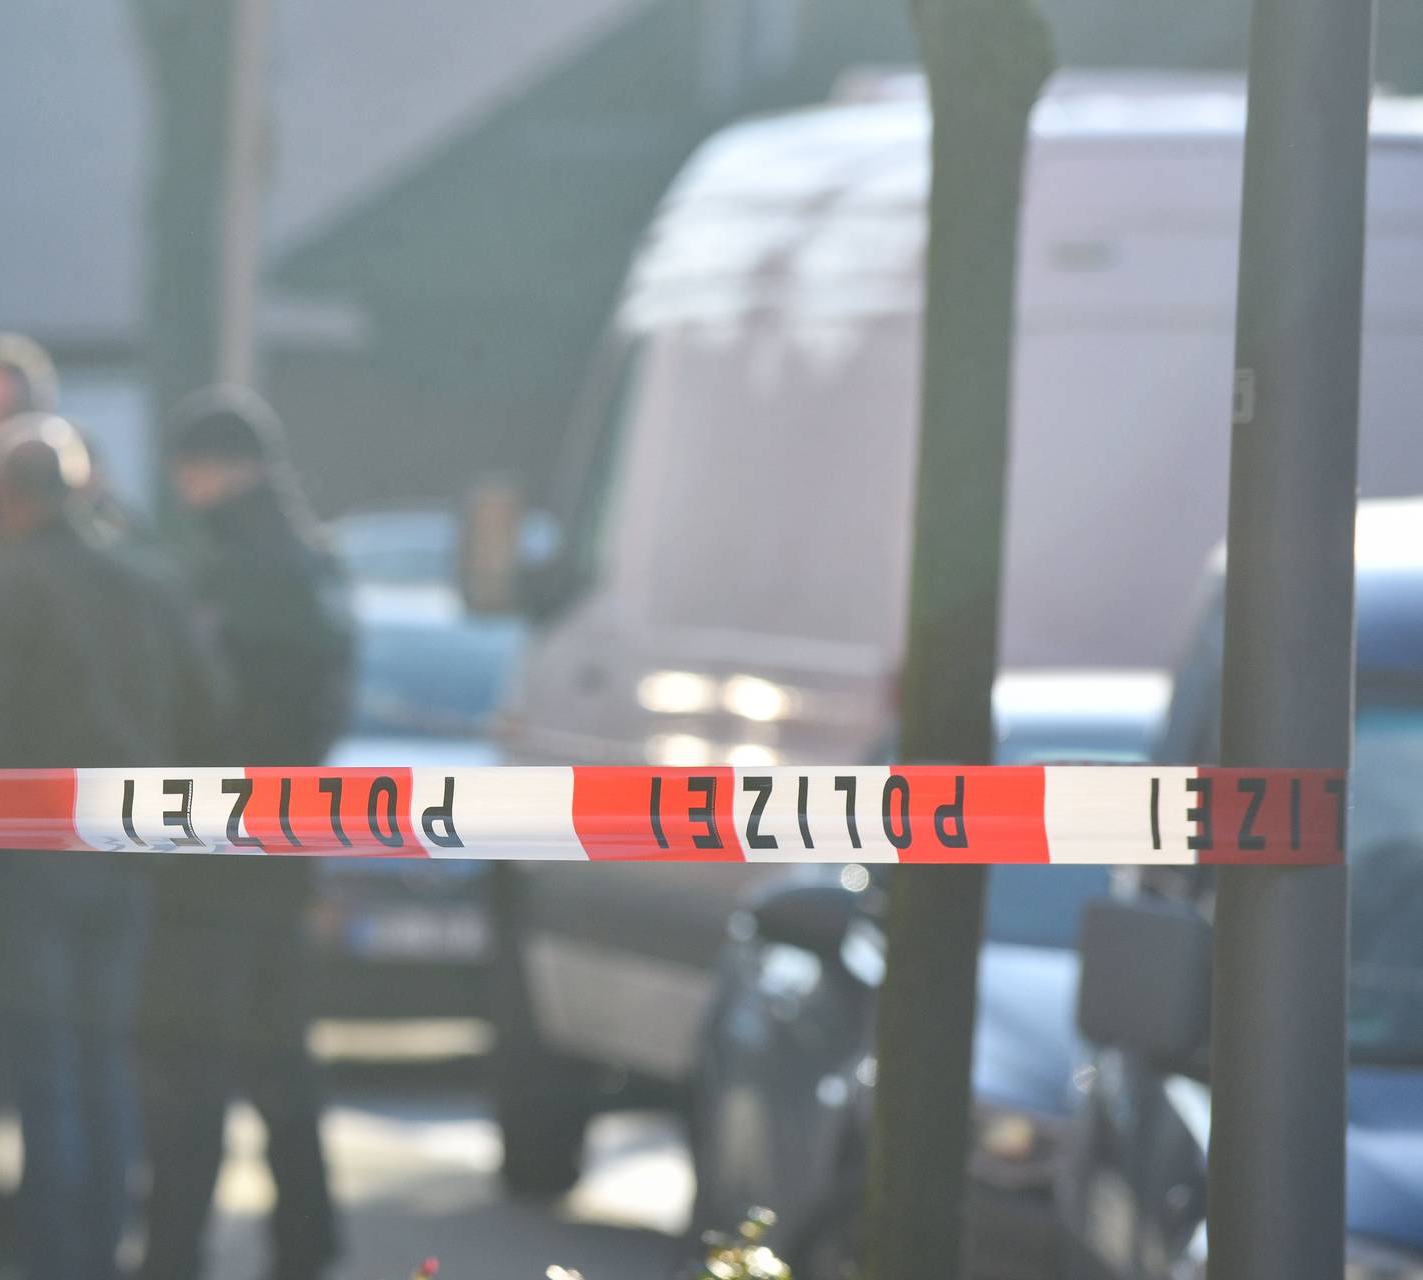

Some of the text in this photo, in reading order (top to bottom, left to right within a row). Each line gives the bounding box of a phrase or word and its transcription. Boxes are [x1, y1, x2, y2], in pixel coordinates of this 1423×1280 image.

[122, 776, 464, 848] POLIZEI
[650, 774, 968, 849] POLIZEI
[1151, 778, 1345, 850] LIZEI
